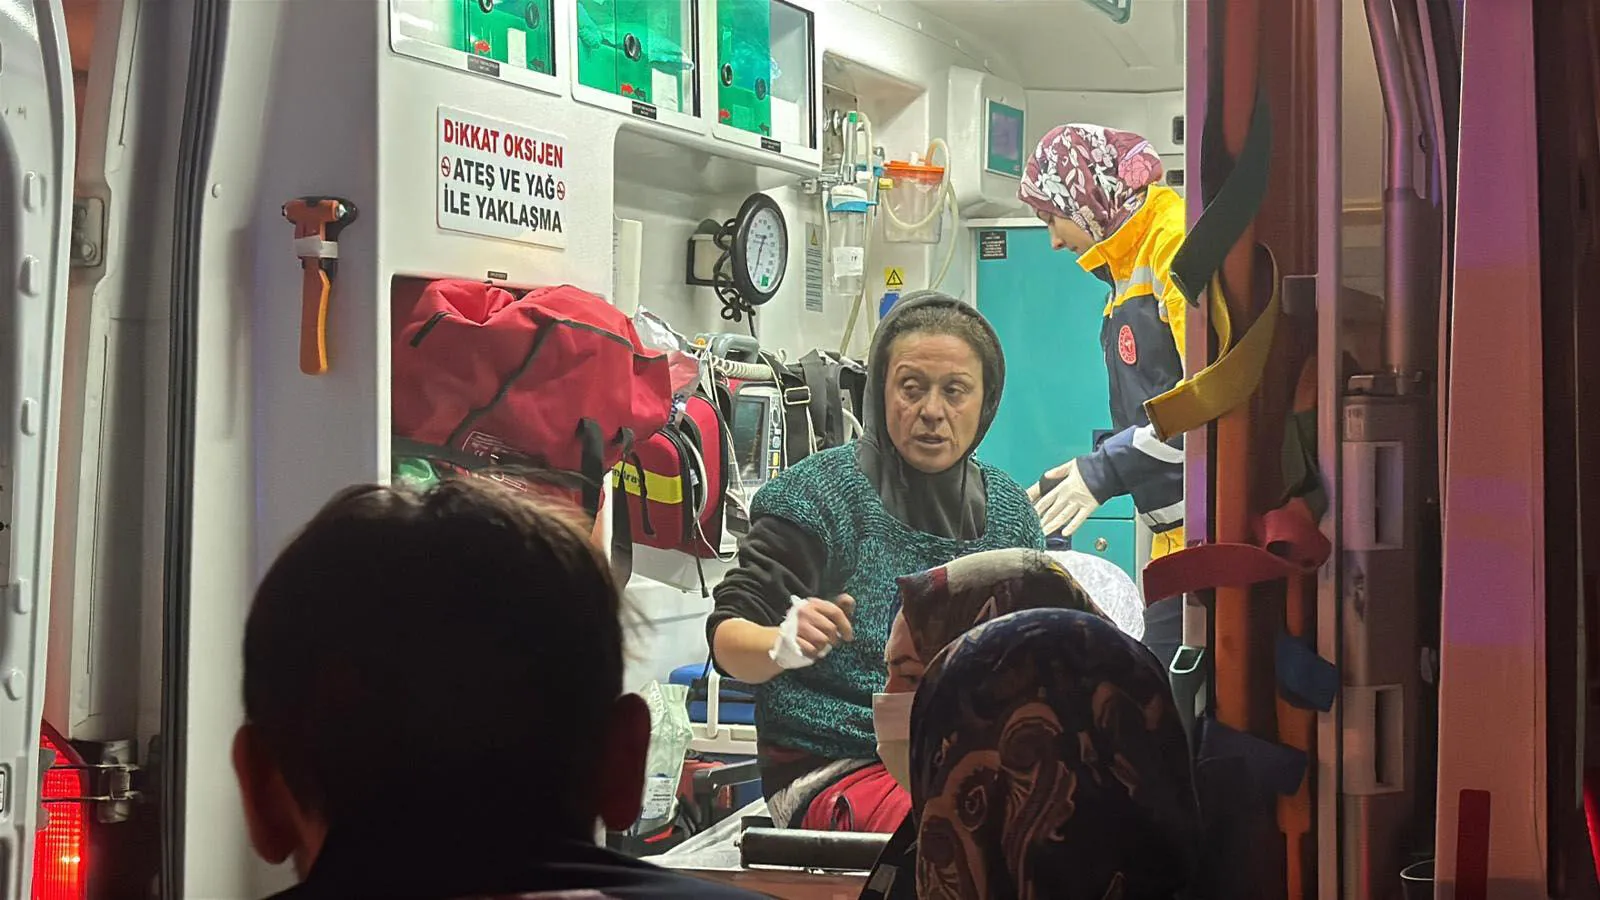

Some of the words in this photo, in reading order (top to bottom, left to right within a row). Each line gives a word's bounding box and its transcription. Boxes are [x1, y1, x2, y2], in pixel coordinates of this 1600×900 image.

[453, 157, 495, 191] ATEŞ
[500, 166, 520, 193] VE
[525, 172, 555, 200] YAĞ
[444, 183, 470, 216] İLE
[476, 195, 562, 233] YAKLAŞMA
